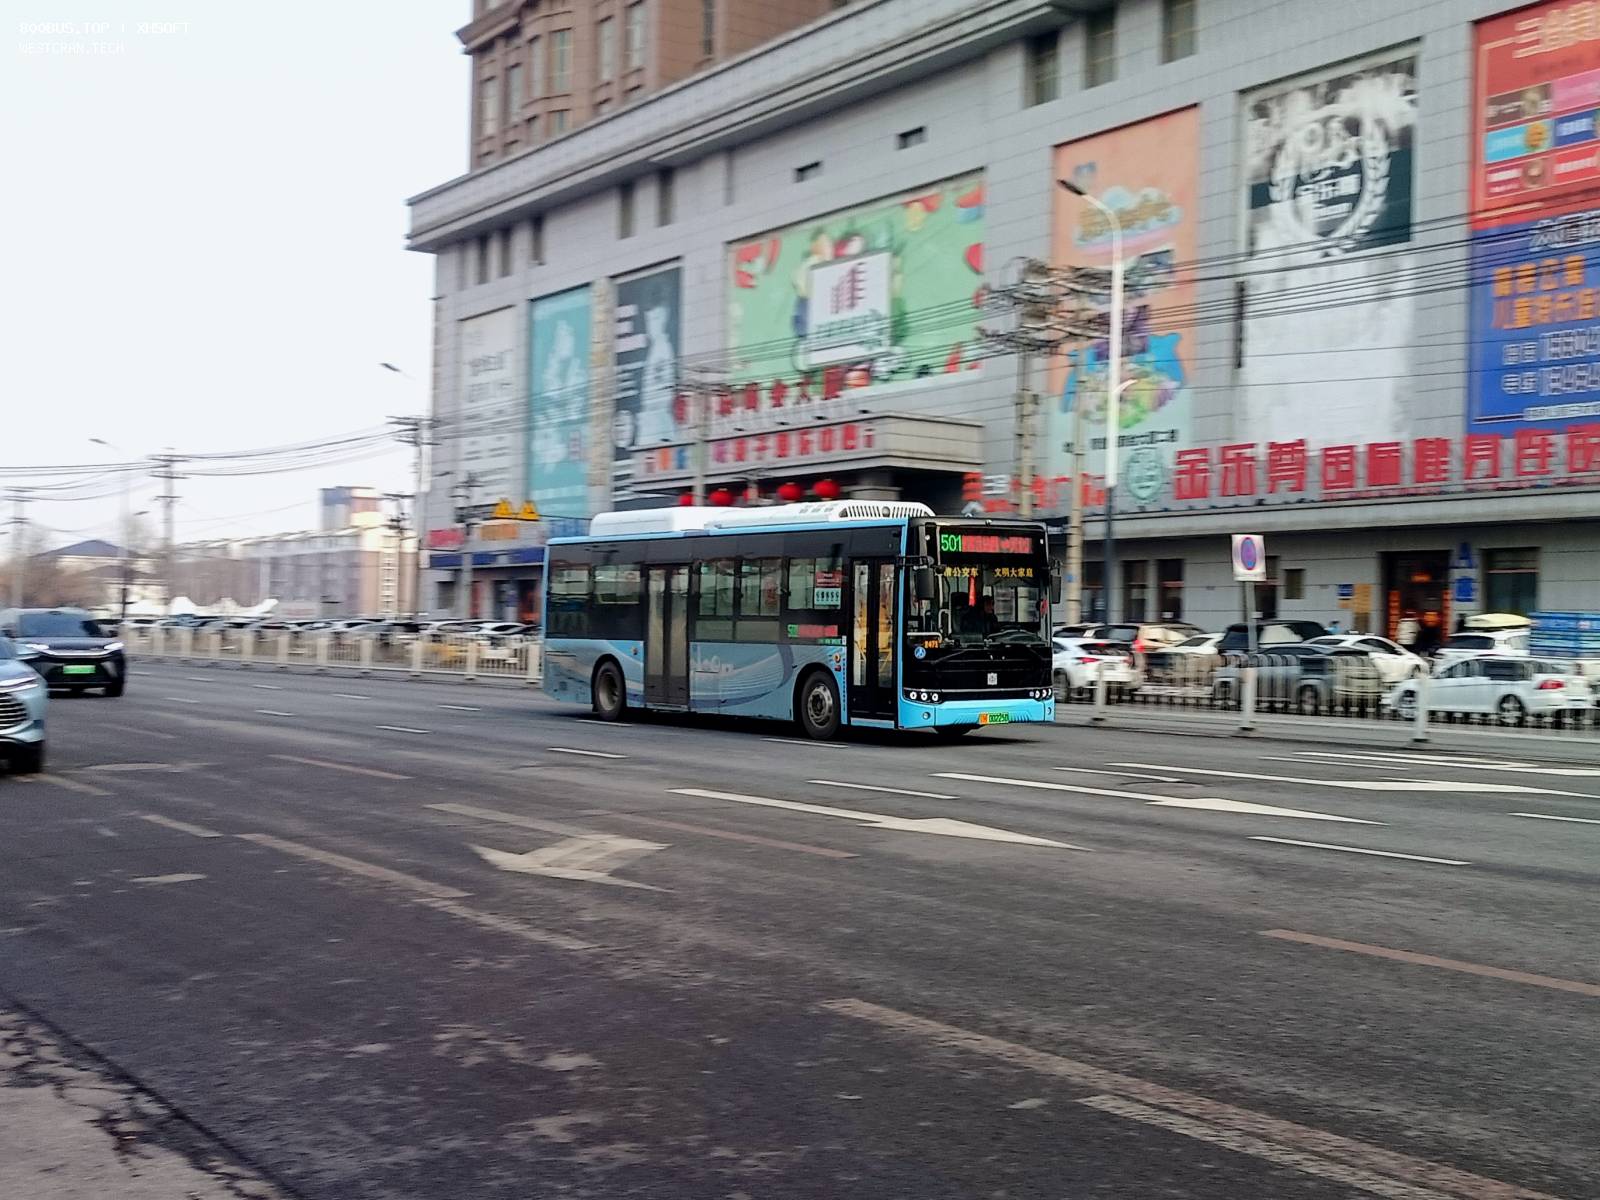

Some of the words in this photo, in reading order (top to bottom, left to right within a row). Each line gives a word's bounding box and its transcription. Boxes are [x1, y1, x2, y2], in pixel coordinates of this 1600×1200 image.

[941, 534, 962, 552] 501
[994, 567, 1034, 577] 文明大家庭
